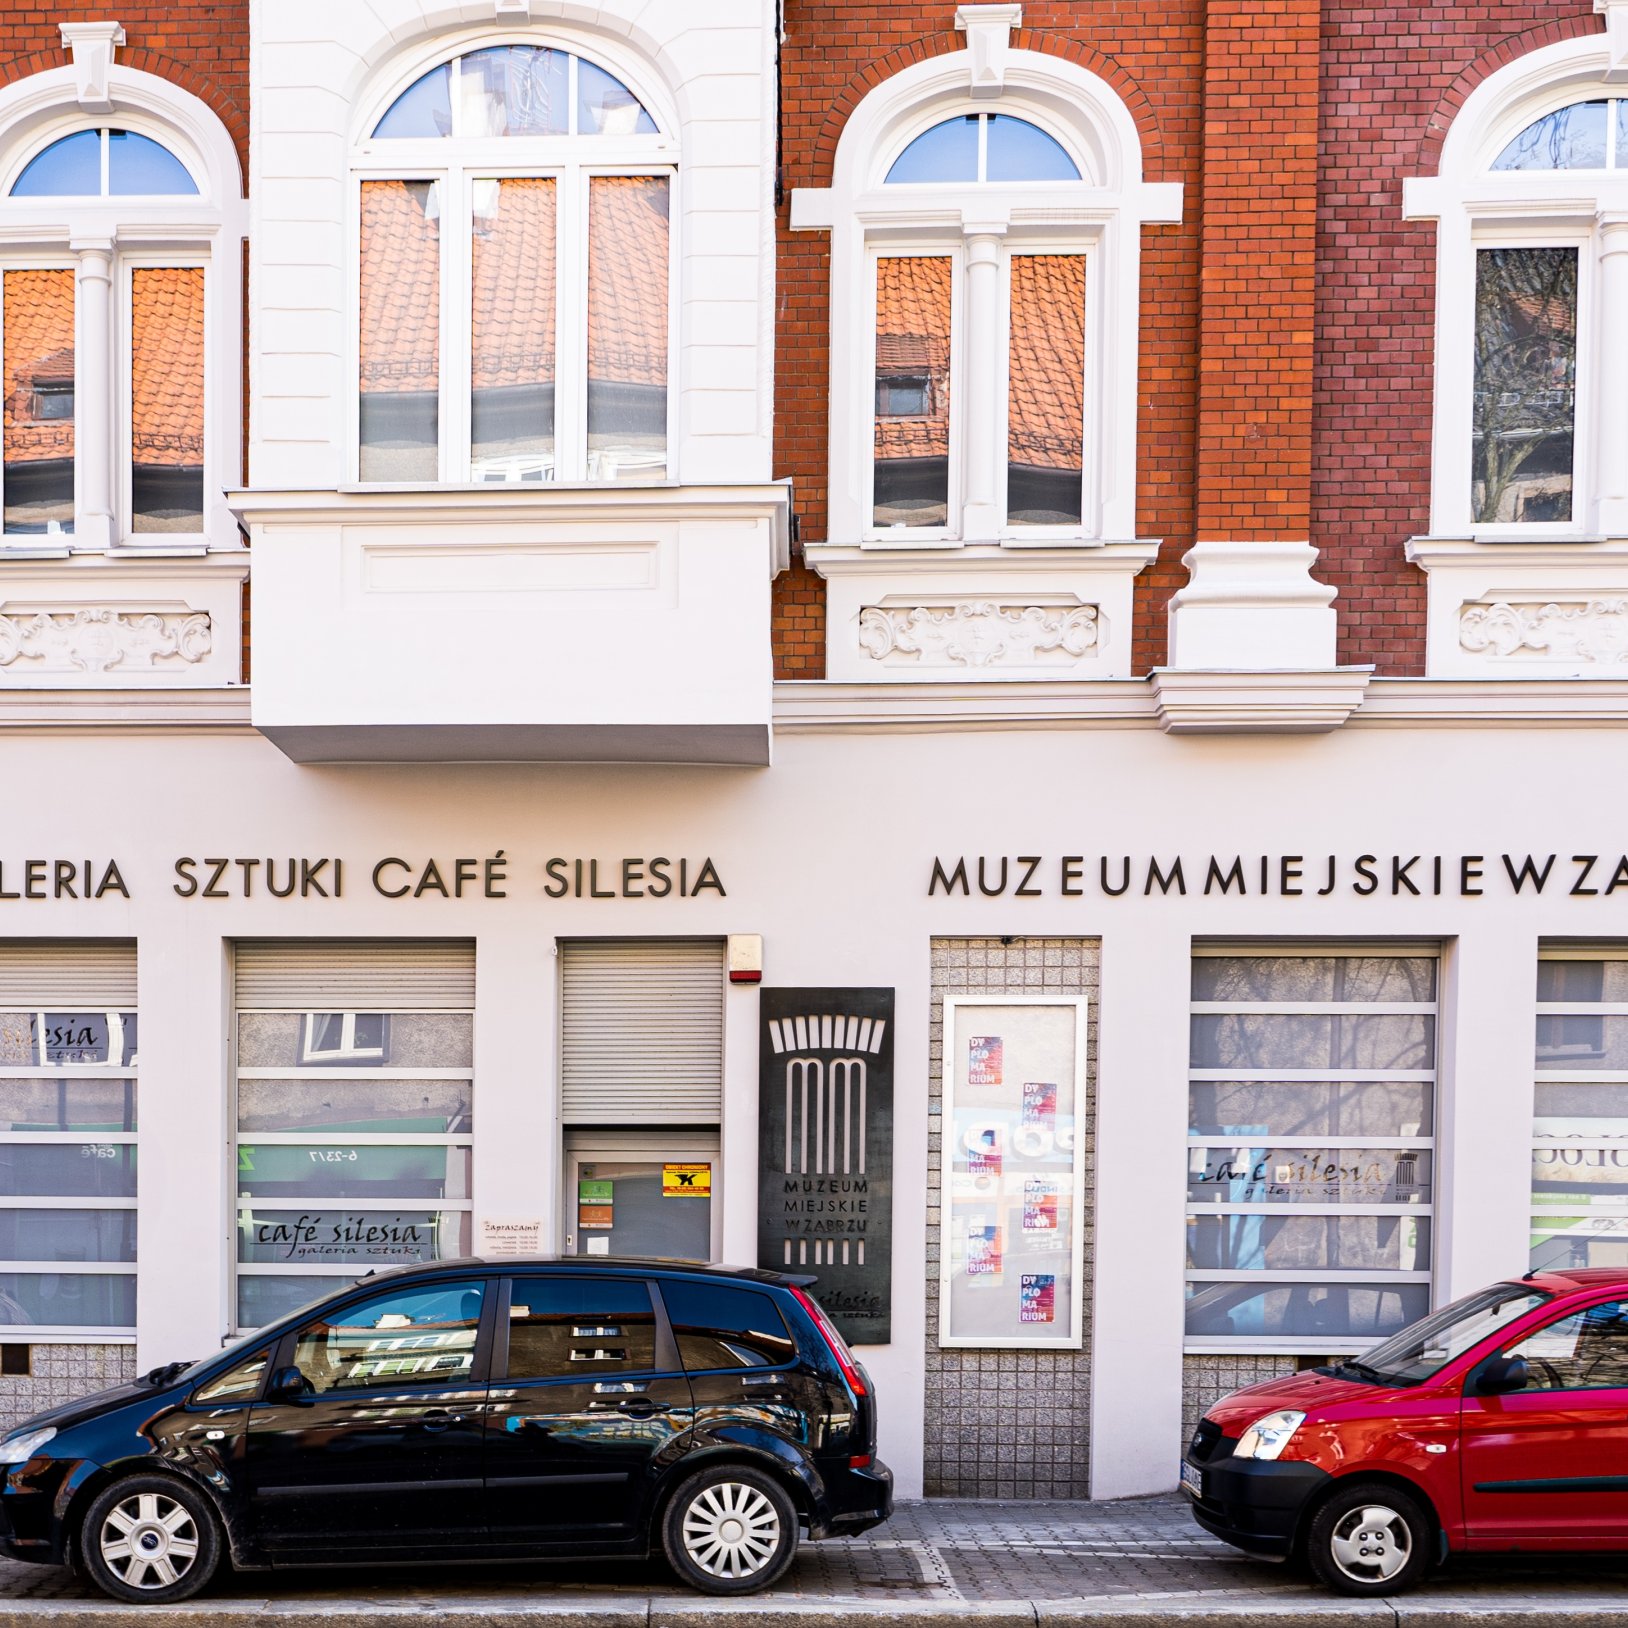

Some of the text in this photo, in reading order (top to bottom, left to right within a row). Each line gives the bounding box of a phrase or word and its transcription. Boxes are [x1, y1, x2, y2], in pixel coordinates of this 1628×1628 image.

[0, 850, 727, 898] LERIA SZTUKI CAFÉ SILESIA
[928, 855, 1187, 896] MUZEUM
[1203, 854, 1484, 896] MIEJSKIE
[1501, 854, 1557, 895] W
[784, 1180, 868, 1193] MUZEUM
[784, 1200, 867, 1213] MIEJSKIE
[804, 1219, 867, 1232] ZABRZU
[259, 1215, 421, 1258] café silesia
[298, 1245, 421, 1258] galeria sztuki
